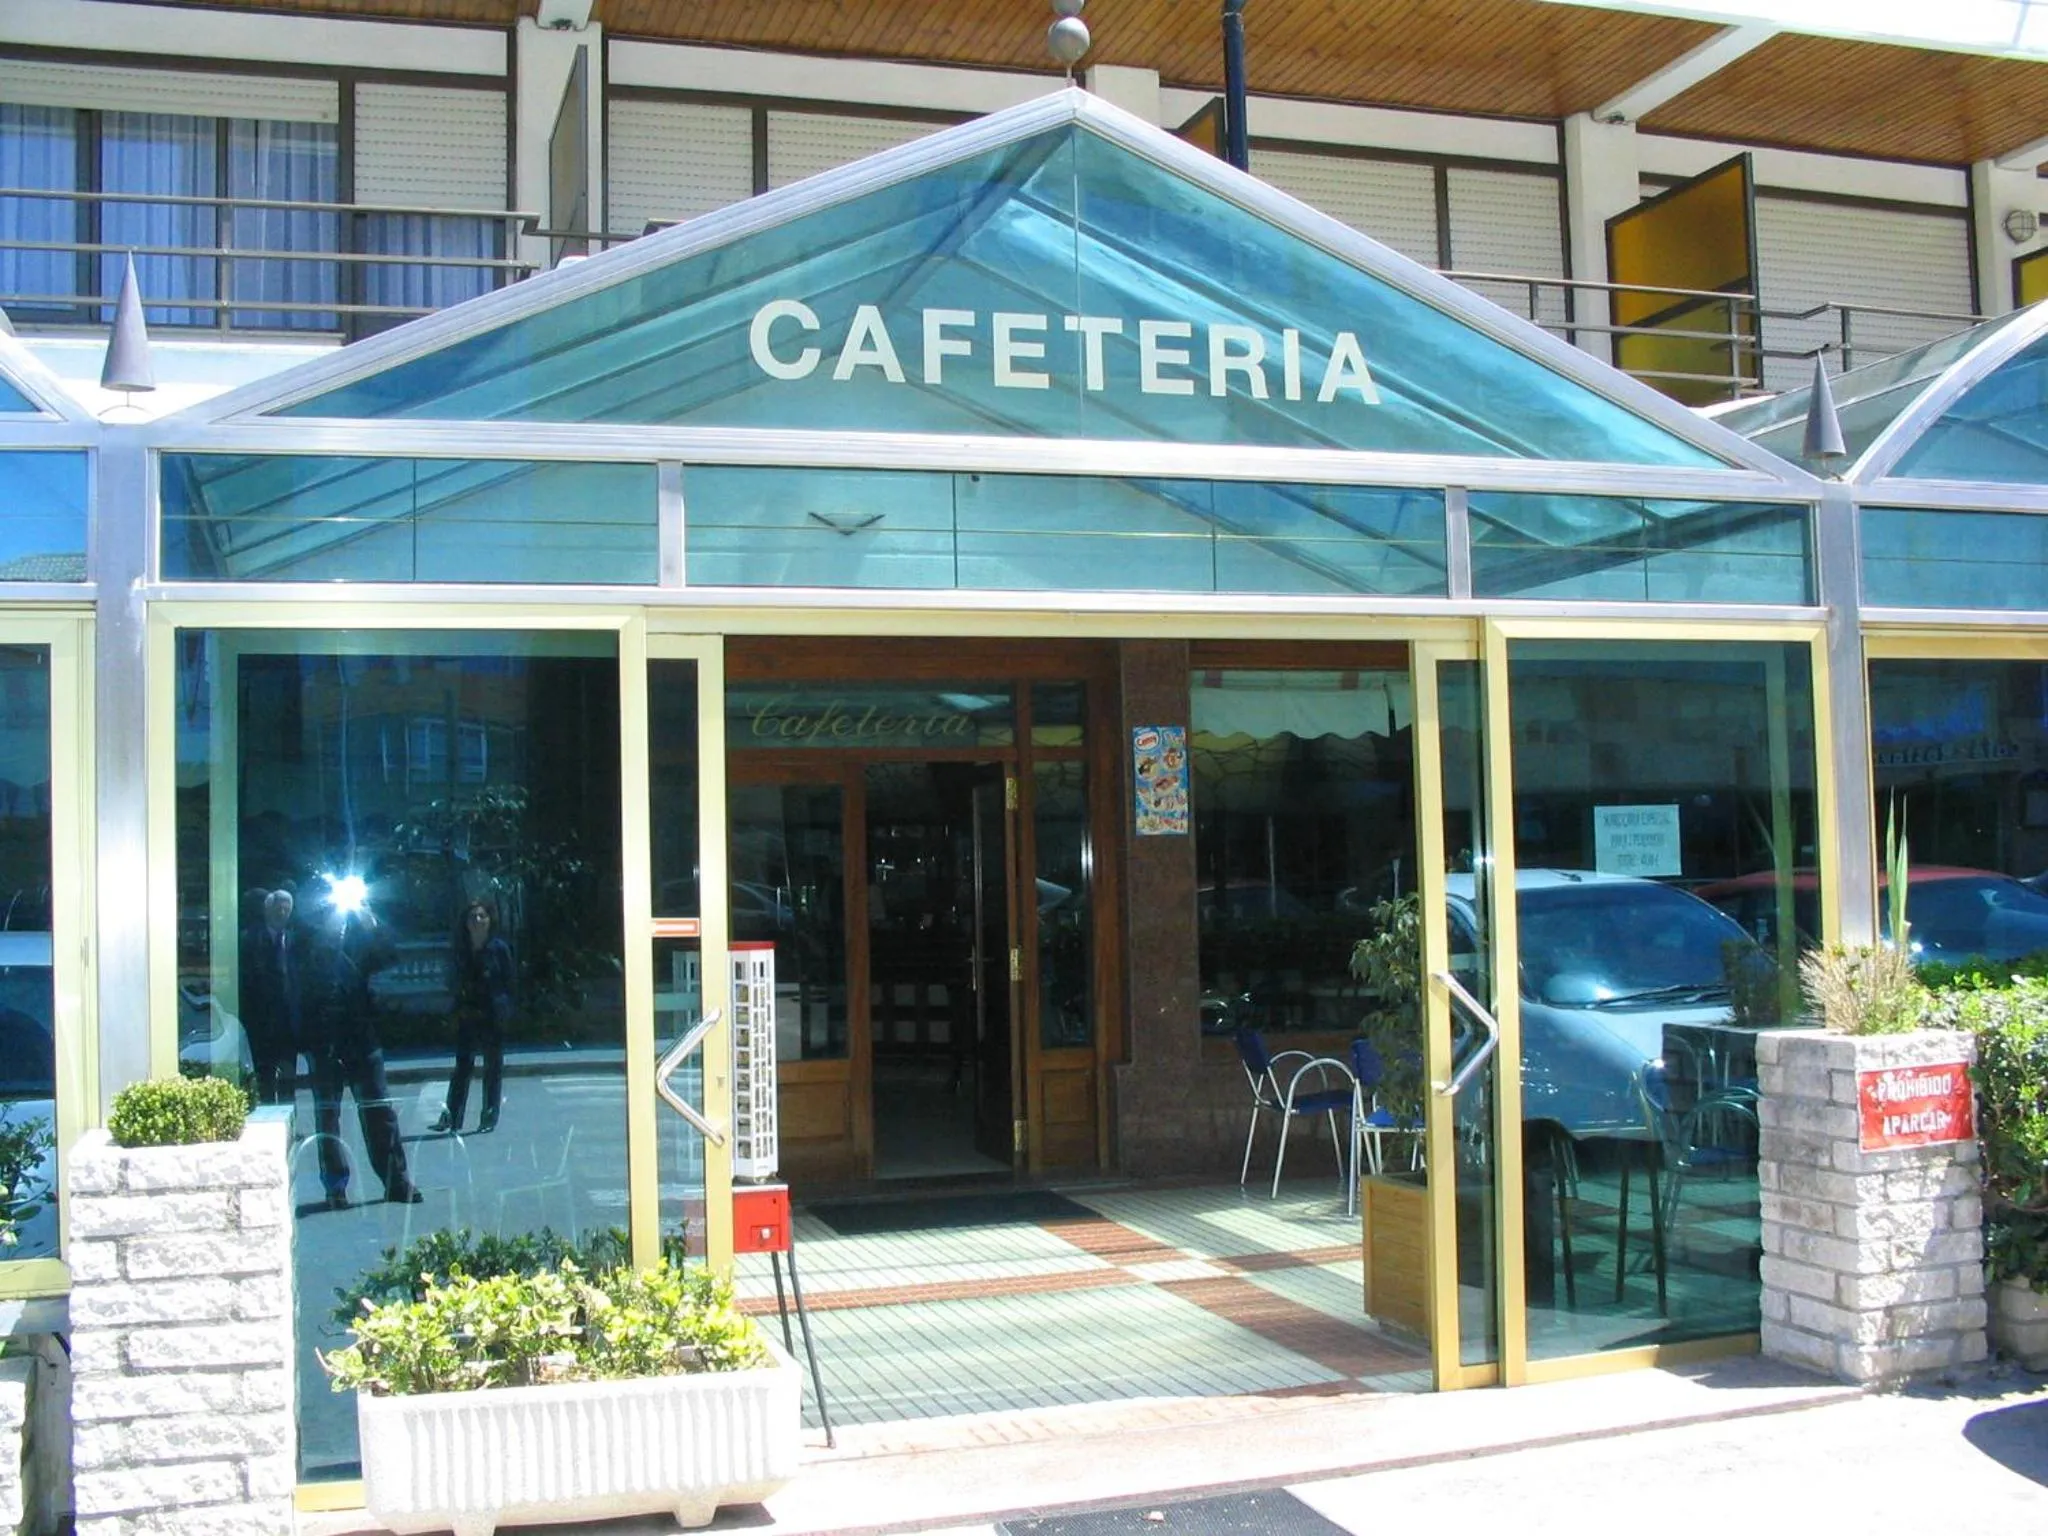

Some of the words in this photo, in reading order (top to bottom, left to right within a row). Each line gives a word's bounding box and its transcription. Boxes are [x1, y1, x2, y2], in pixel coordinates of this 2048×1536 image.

[749, 299, 1380, 404] CAFETERIA
[746, 699, 974, 743] Cafeteria
[1877, 1073, 1952, 1102] PROHIBIDO
[1883, 1110, 1952, 1136] APARCAR
